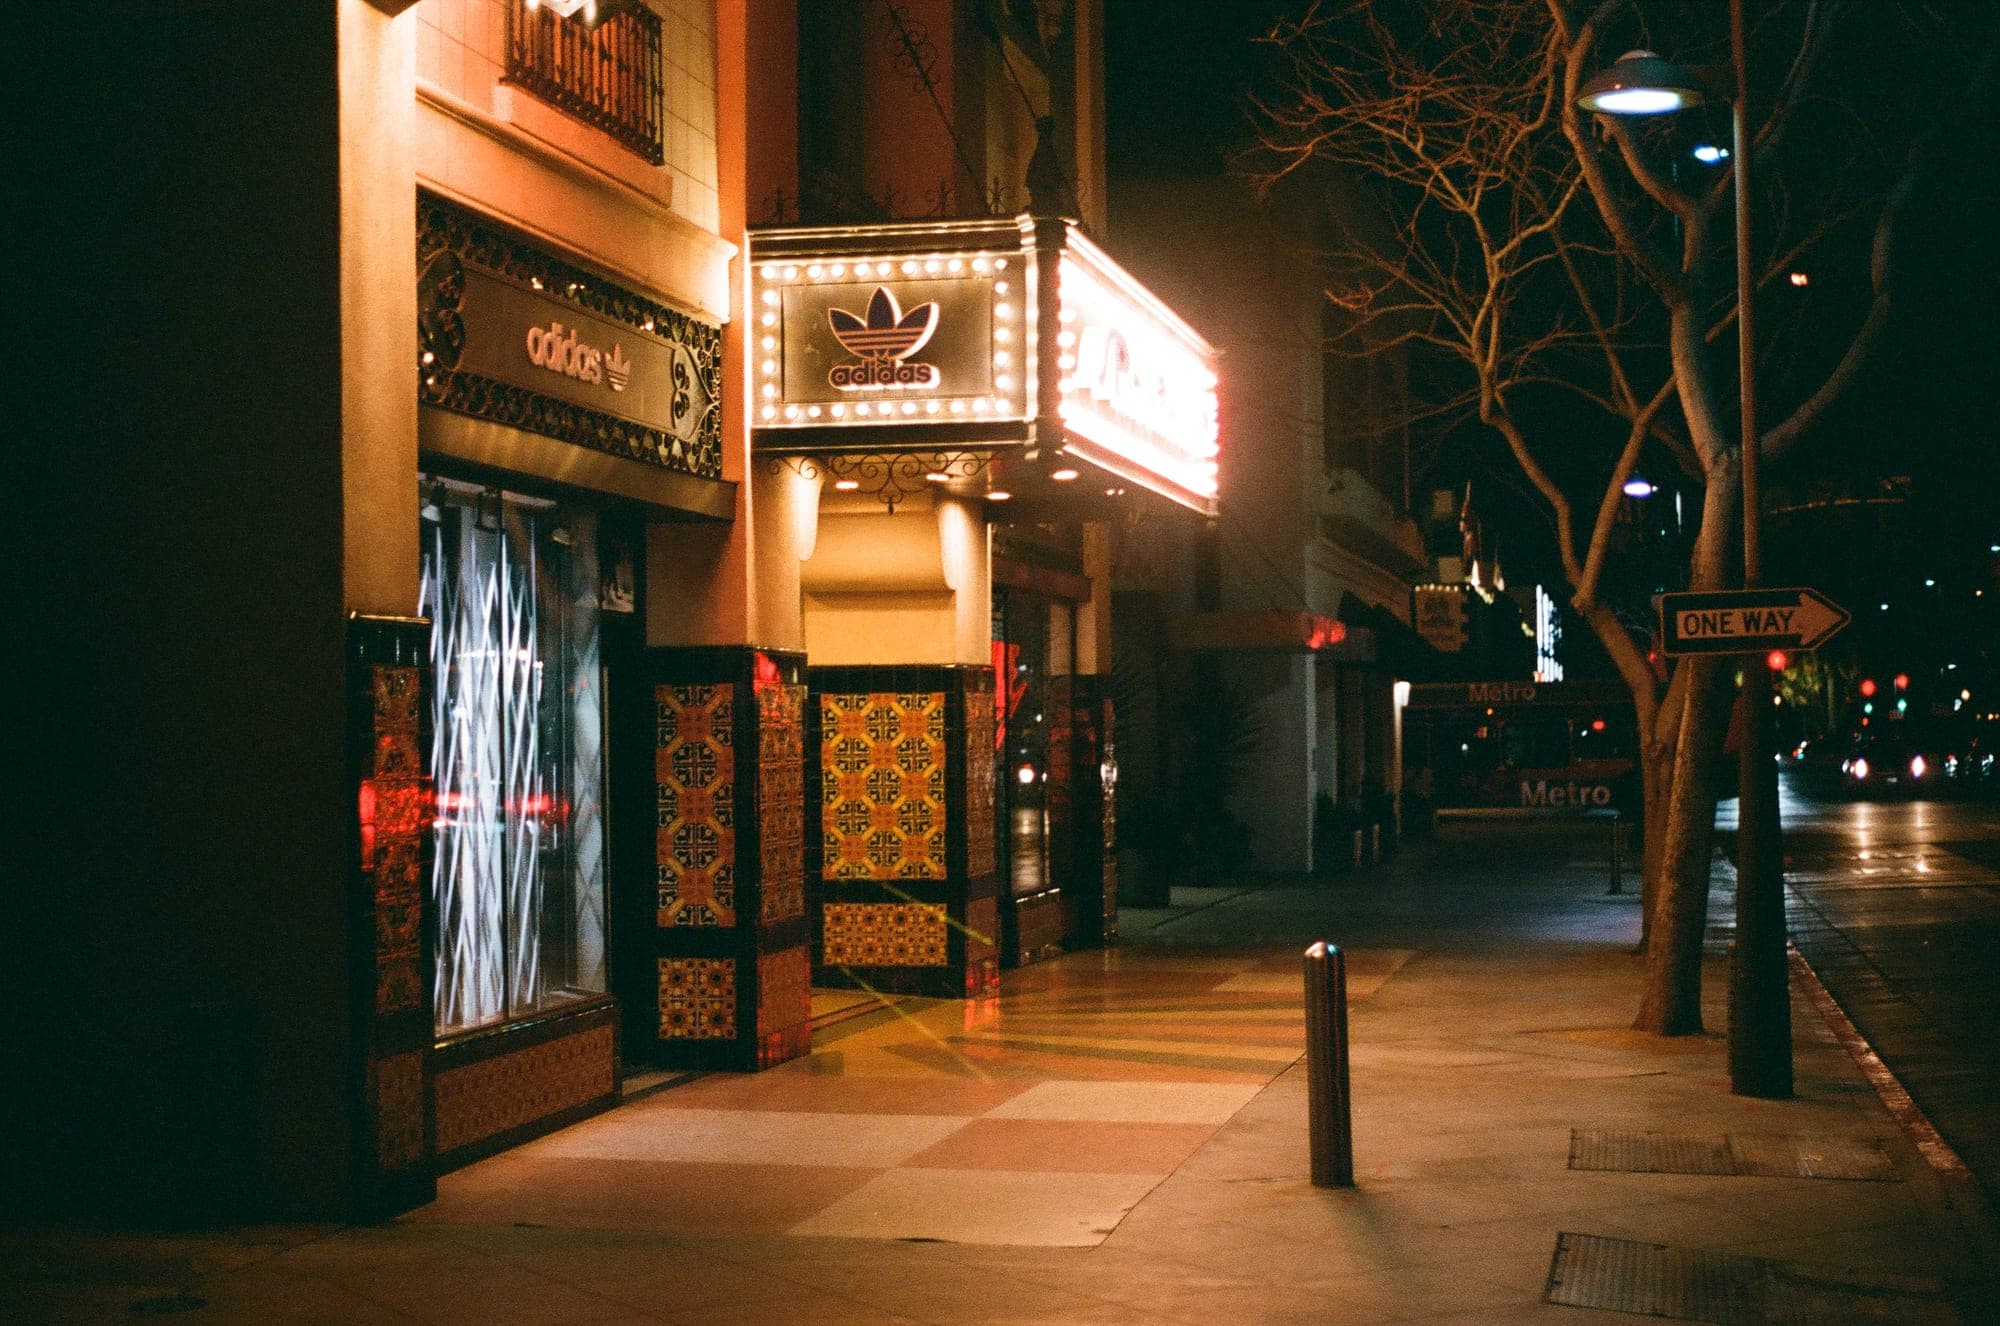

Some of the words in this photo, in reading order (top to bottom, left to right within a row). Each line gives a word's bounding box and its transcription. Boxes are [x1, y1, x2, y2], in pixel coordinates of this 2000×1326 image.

[526, 322, 602, 384] adidas
[828, 360, 940, 391] adidas
[1683, 611, 1735, 637] ONE
[1742, 608, 1795, 634] WAY
[1468, 682, 1537, 702] Metro
[1519, 779, 1612, 807] Metro
